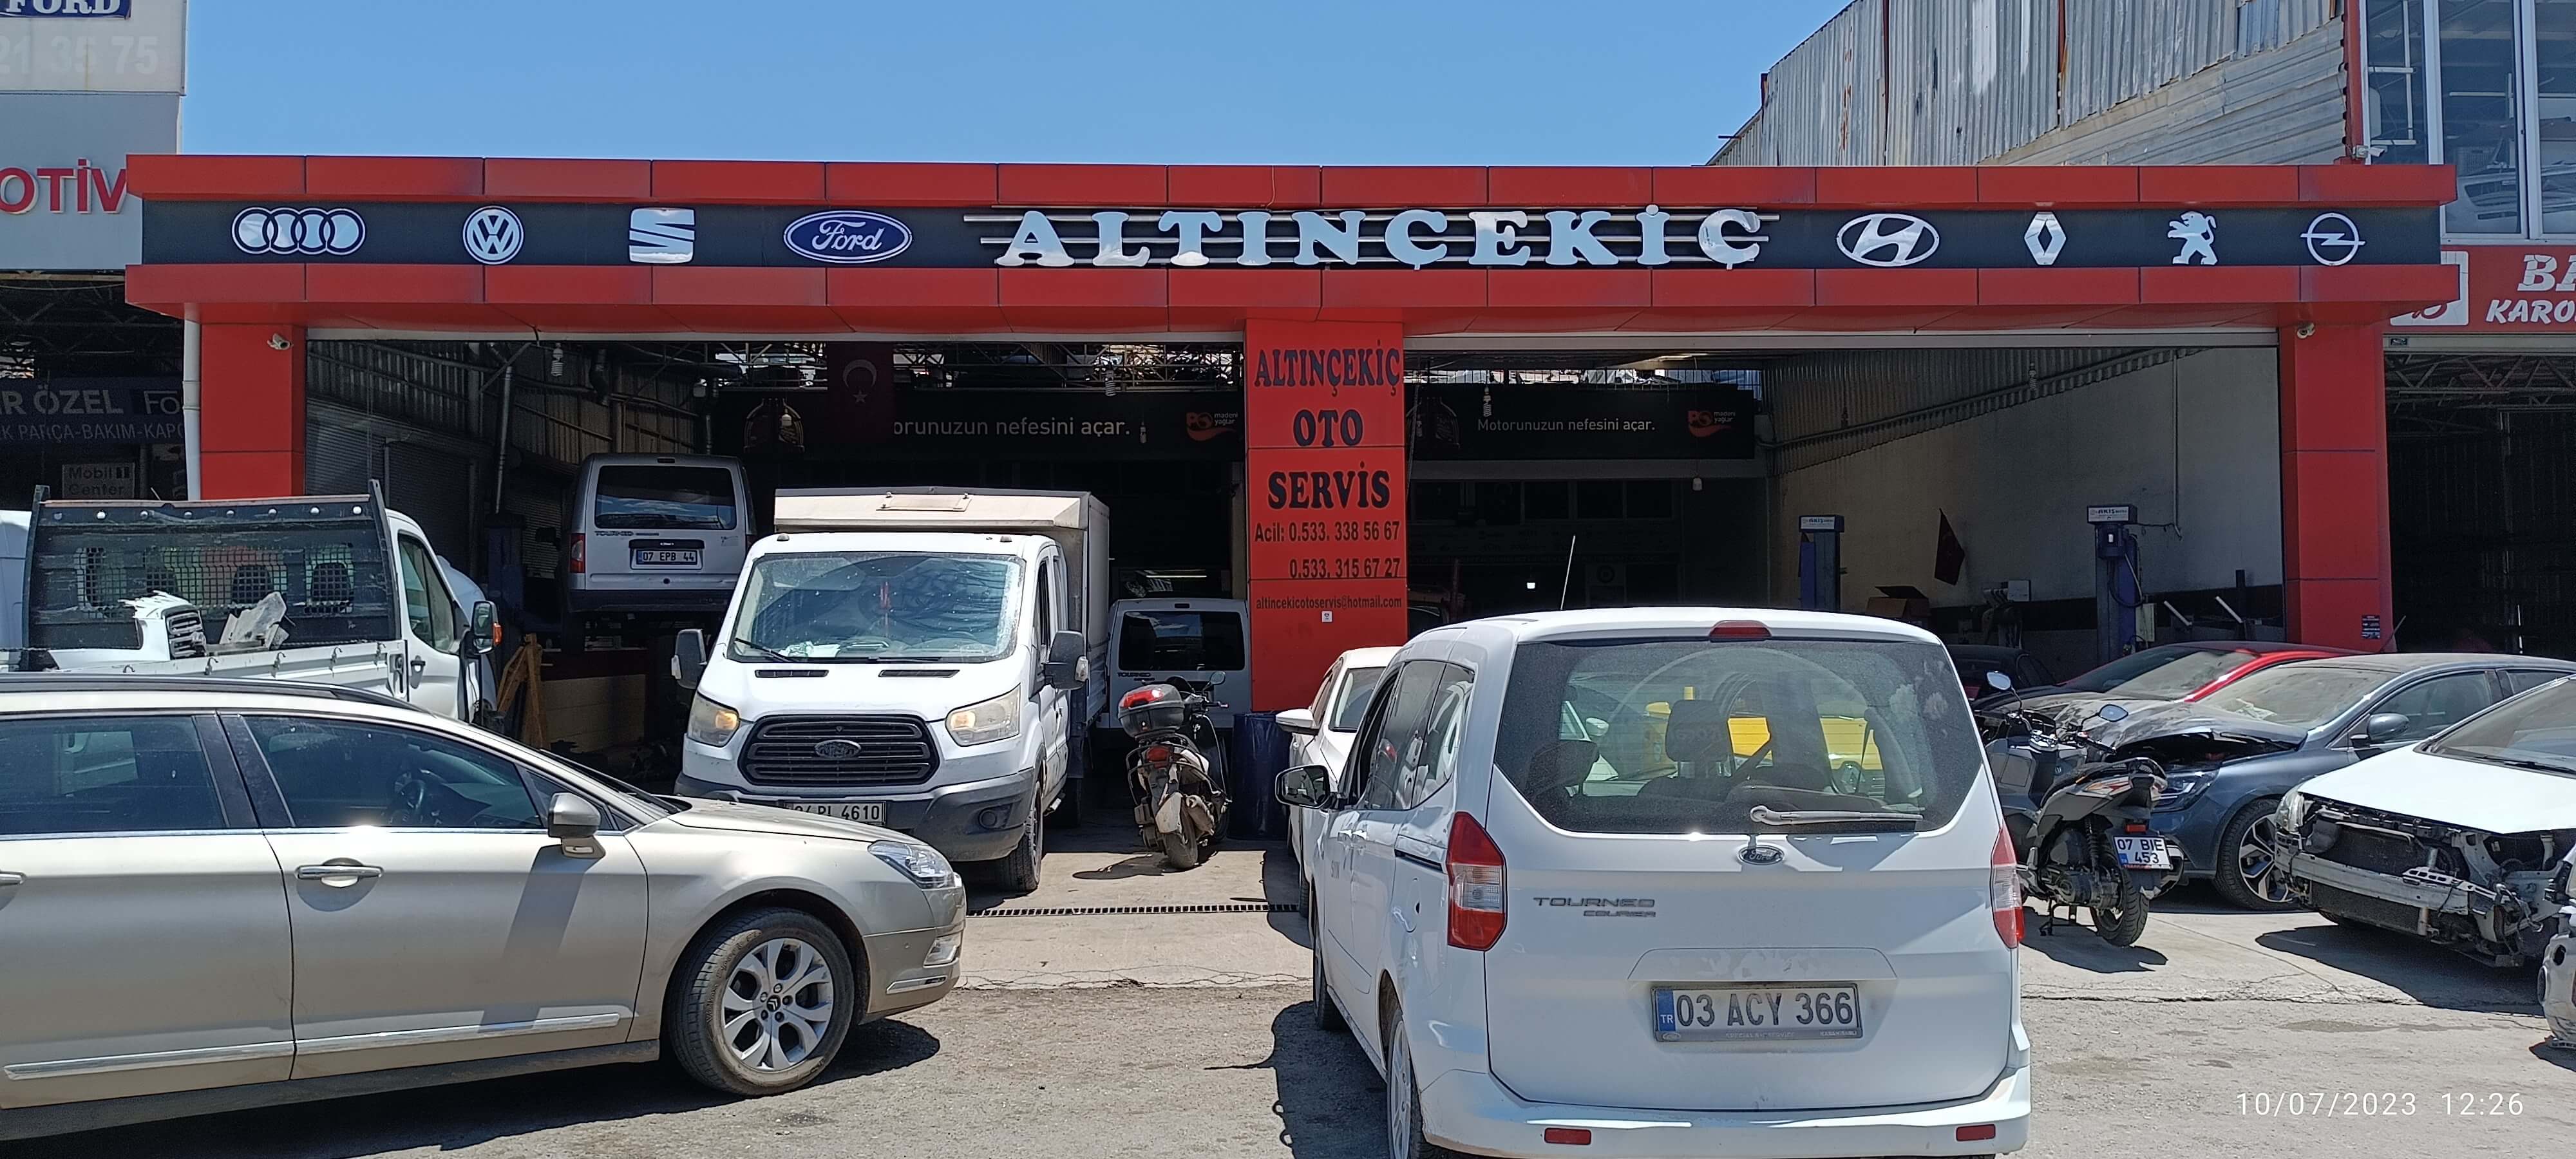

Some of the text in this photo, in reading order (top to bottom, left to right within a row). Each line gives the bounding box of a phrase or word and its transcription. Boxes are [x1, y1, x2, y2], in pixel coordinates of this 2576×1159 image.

[111, 36, 158, 75] 75
[811, 220, 886, 252] Ford
[996, 204, 1761, 270] ALTINÇEKİÇ
[1254, 339, 1400, 397] ALTINÇEKİÇ
[33, 384, 124, 415] ÖZEL
[893, 417, 1131, 438] orunuzun nefesini açar.
[1293, 409, 1363, 447] OTO
[1477, 417, 1656, 433] Motorunuzun nefesini açar.
[69, 467, 113, 480] Mobil
[68, 483, 125, 496] Center
[1267, 460, 1390, 509] SERVİS
[1255, 522, 1285, 542] Acil:
[1289, 522, 1330, 542] 0.533.
[1334, 521, 1359, 541] 338
[1363, 521, 1379, 541] 56
[1384, 520, 1400, 540] 67
[643, 552, 694, 561] 07 EPB 44
[1289, 558, 1331, 578] 0.533.
[1336, 558, 1359, 578] 315
[1364, 558, 1380, 578] 67
[1385, 557, 1401, 578] 27
[1256, 594, 1402, 610] altincekicotoservis@hotmail.com
[841, 805, 880, 820] 4610
[2117, 839, 2133, 850] 07
[2135, 852, 2159, 863] 453
[1533, 897, 1656, 908] TOURNEO
[1660, 992, 1853, 1027] TR 03 ACY 366
